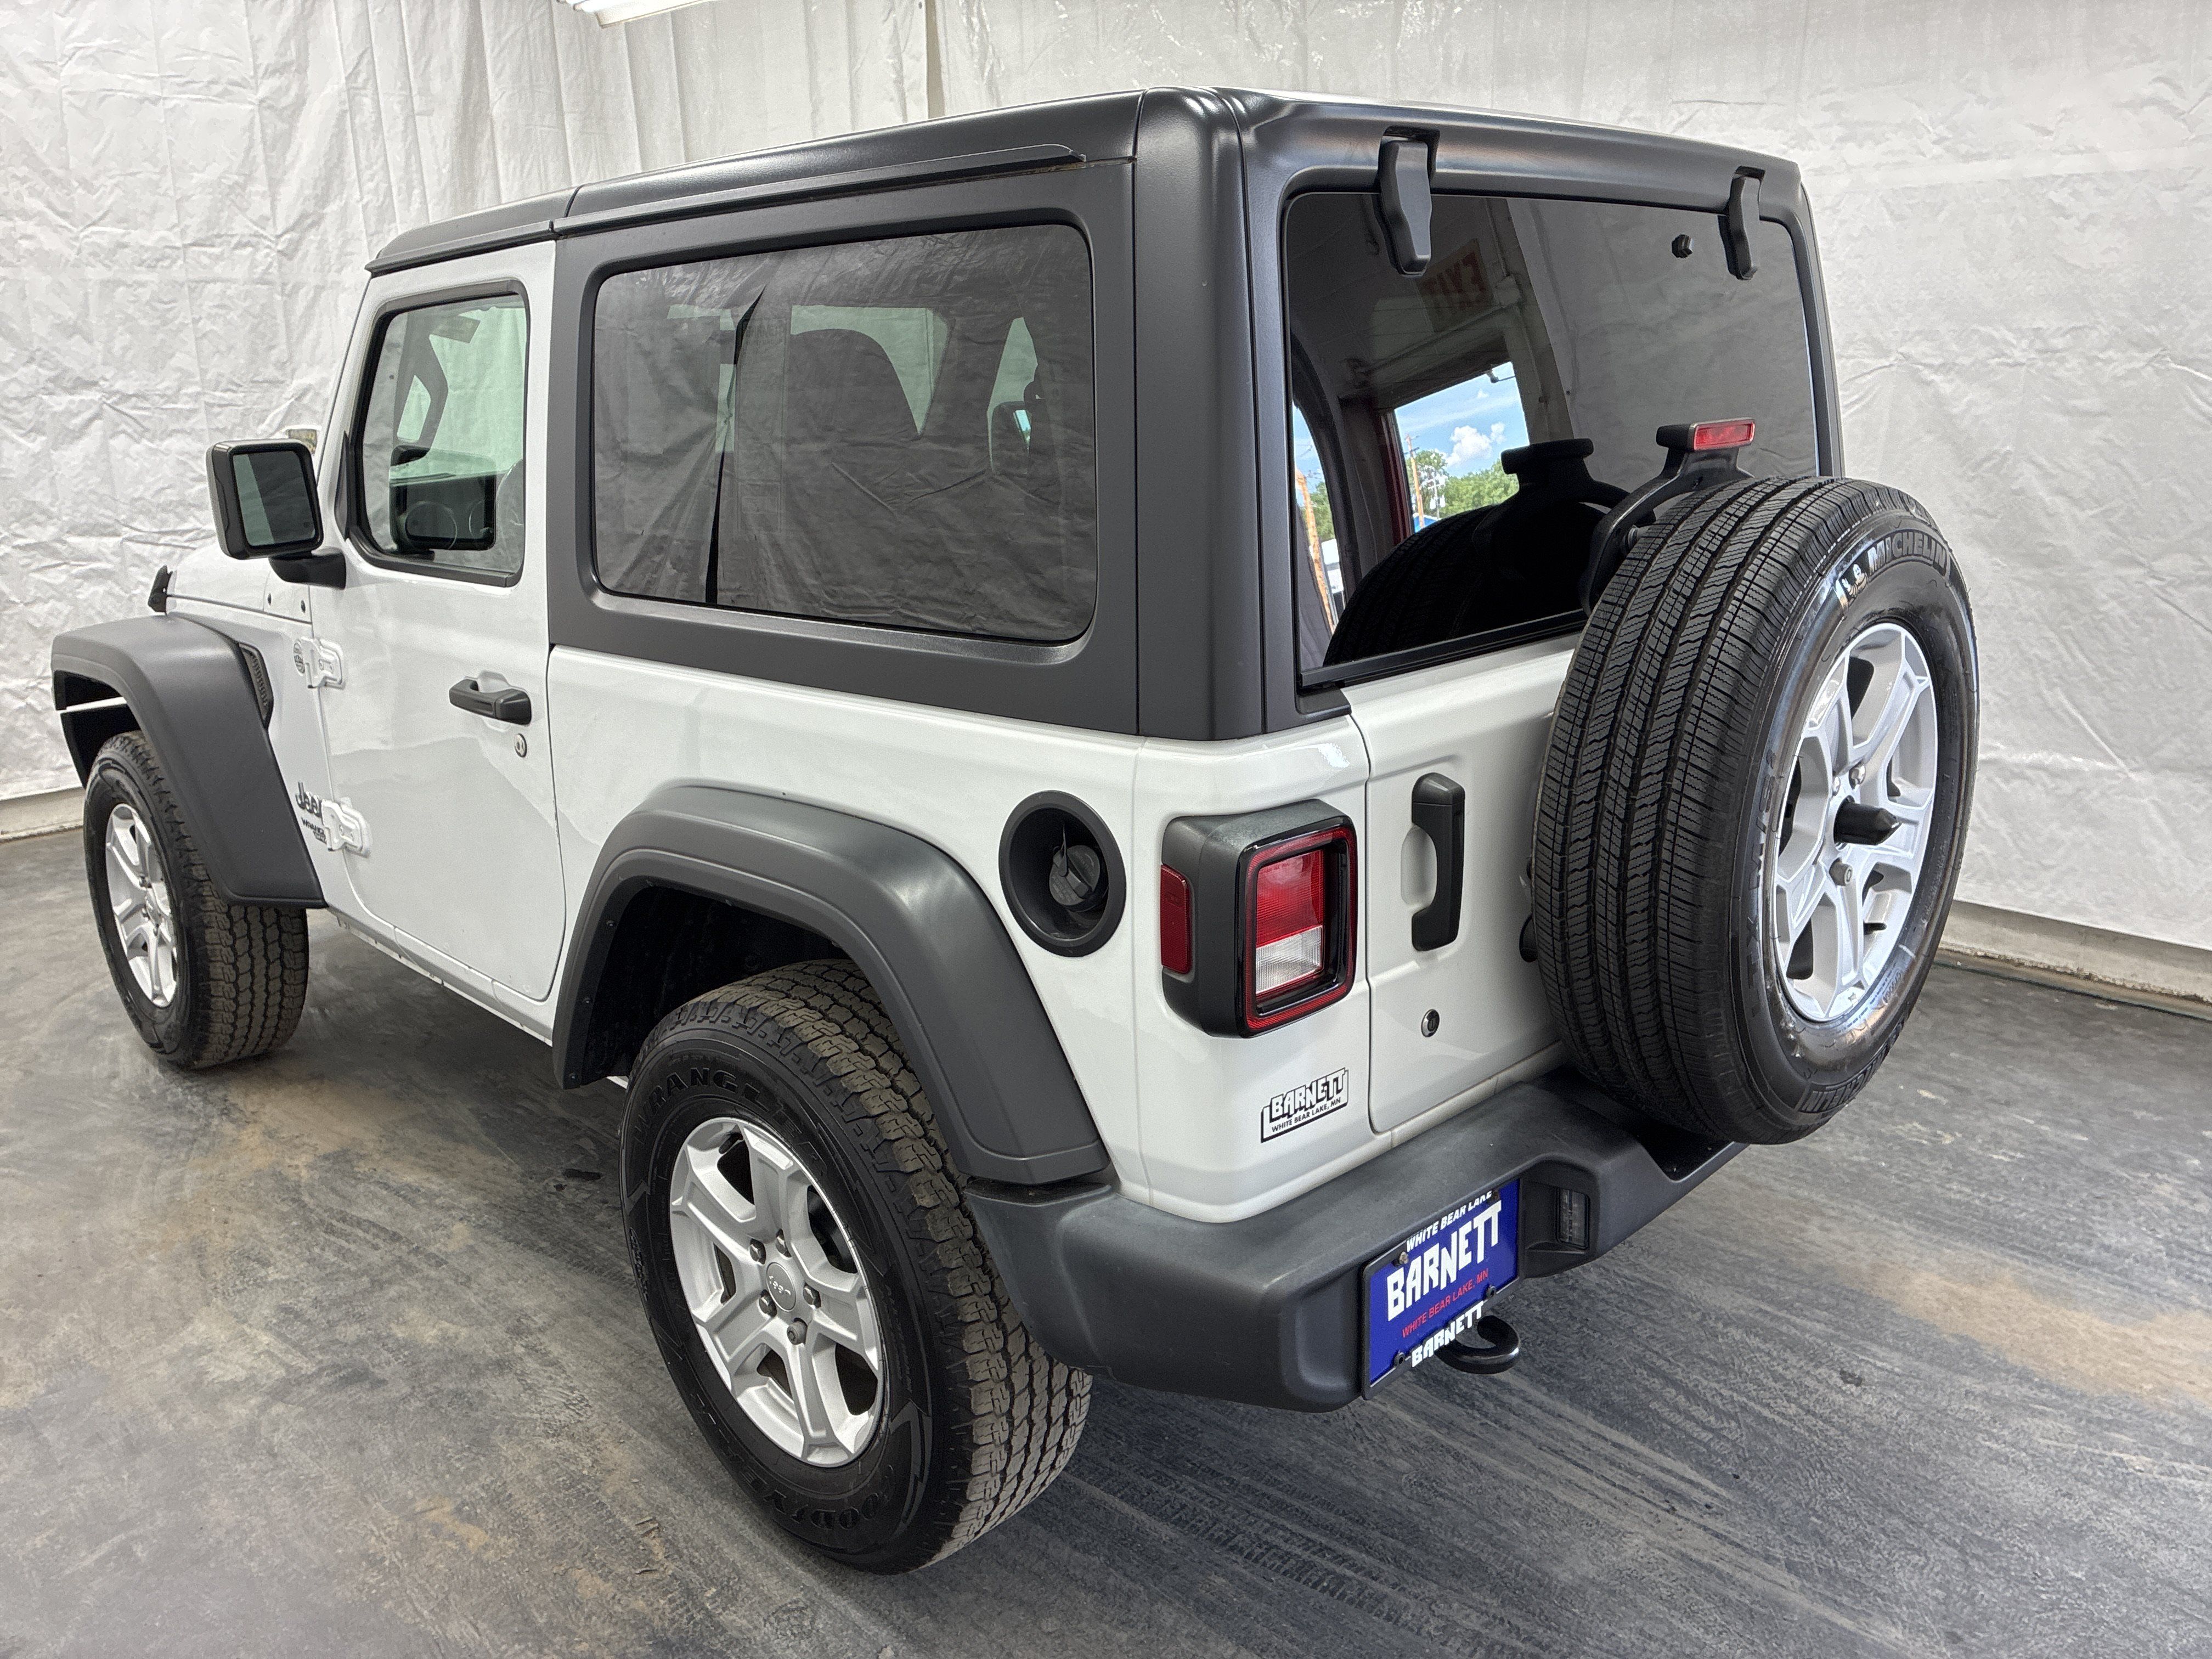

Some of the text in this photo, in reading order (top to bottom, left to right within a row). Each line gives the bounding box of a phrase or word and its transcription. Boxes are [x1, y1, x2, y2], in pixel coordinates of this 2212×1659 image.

[1867, 531, 1948, 577] MICHELIN
[1271, 1067, 1346, 1121] BARNETT
[1272, 1097, 1341, 1132] WHITE BEAR LAKE, MN
[634, 1067, 829, 1176] WRANGLER
[1406, 1221, 1440, 1252] WHITE
[1440, 1204, 1466, 1230] BEAR
[769, 1275, 791, 1295] Jeep
[1386, 1199, 1502, 1322] BARNETT
[1402, 1268, 1488, 1339] WHITE BEAR LAKE, MN
[1412, 1301, 1484, 1368] BARNETT
